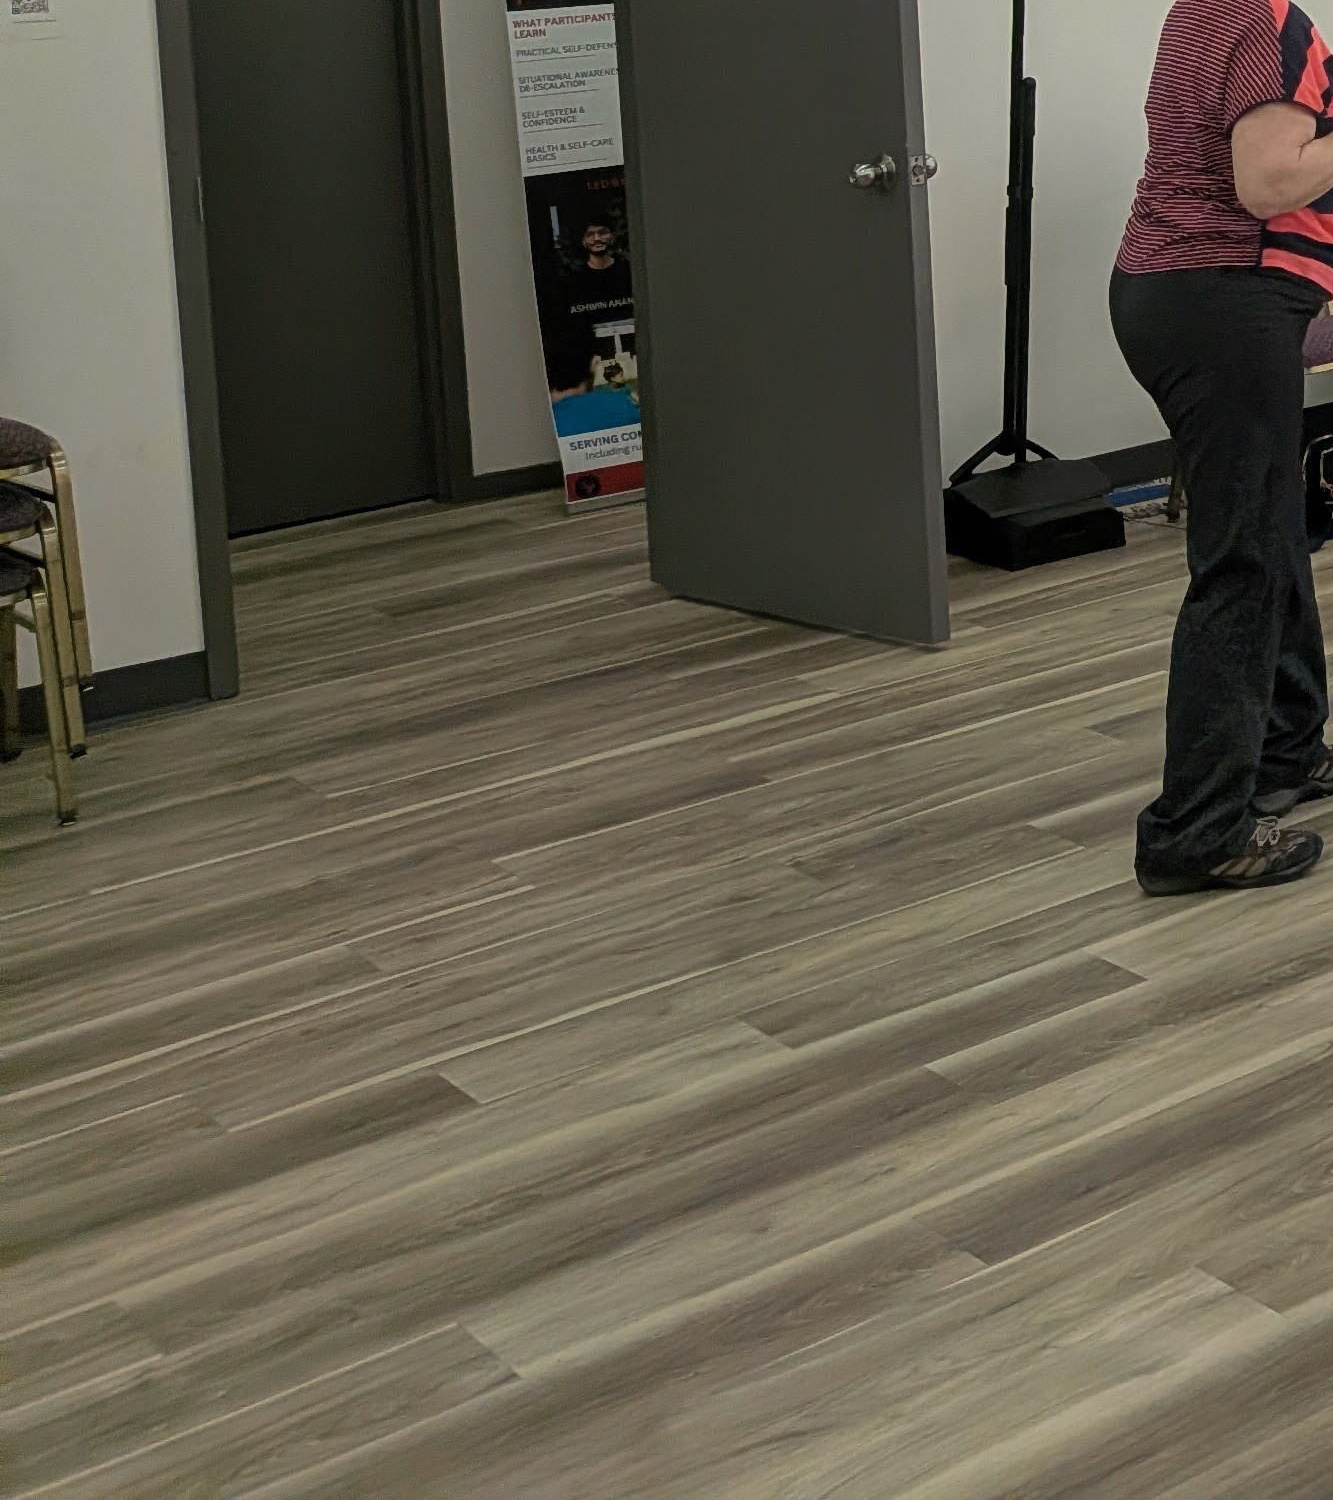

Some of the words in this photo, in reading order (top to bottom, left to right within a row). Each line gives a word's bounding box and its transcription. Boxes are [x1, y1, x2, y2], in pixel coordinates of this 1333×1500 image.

[513, 19, 541, 28] WHAT
[514, 28, 546, 40] LEARN
[516, 47, 561, 57] PRACTICAL
[519, 73, 572, 85] SITUATIONAL
[519, 80, 586, 93] DE-ESCALATION
[522, 107, 577, 120] SELF-ESTEEM
[523, 114, 577, 128] CONFIDENCE
[525, 144, 559, 156] HEALTH
[568, 138, 613, 150] SELF-CARE
[526, 152, 556, 164] BASICS
[569, 433, 619, 451] SERVING
